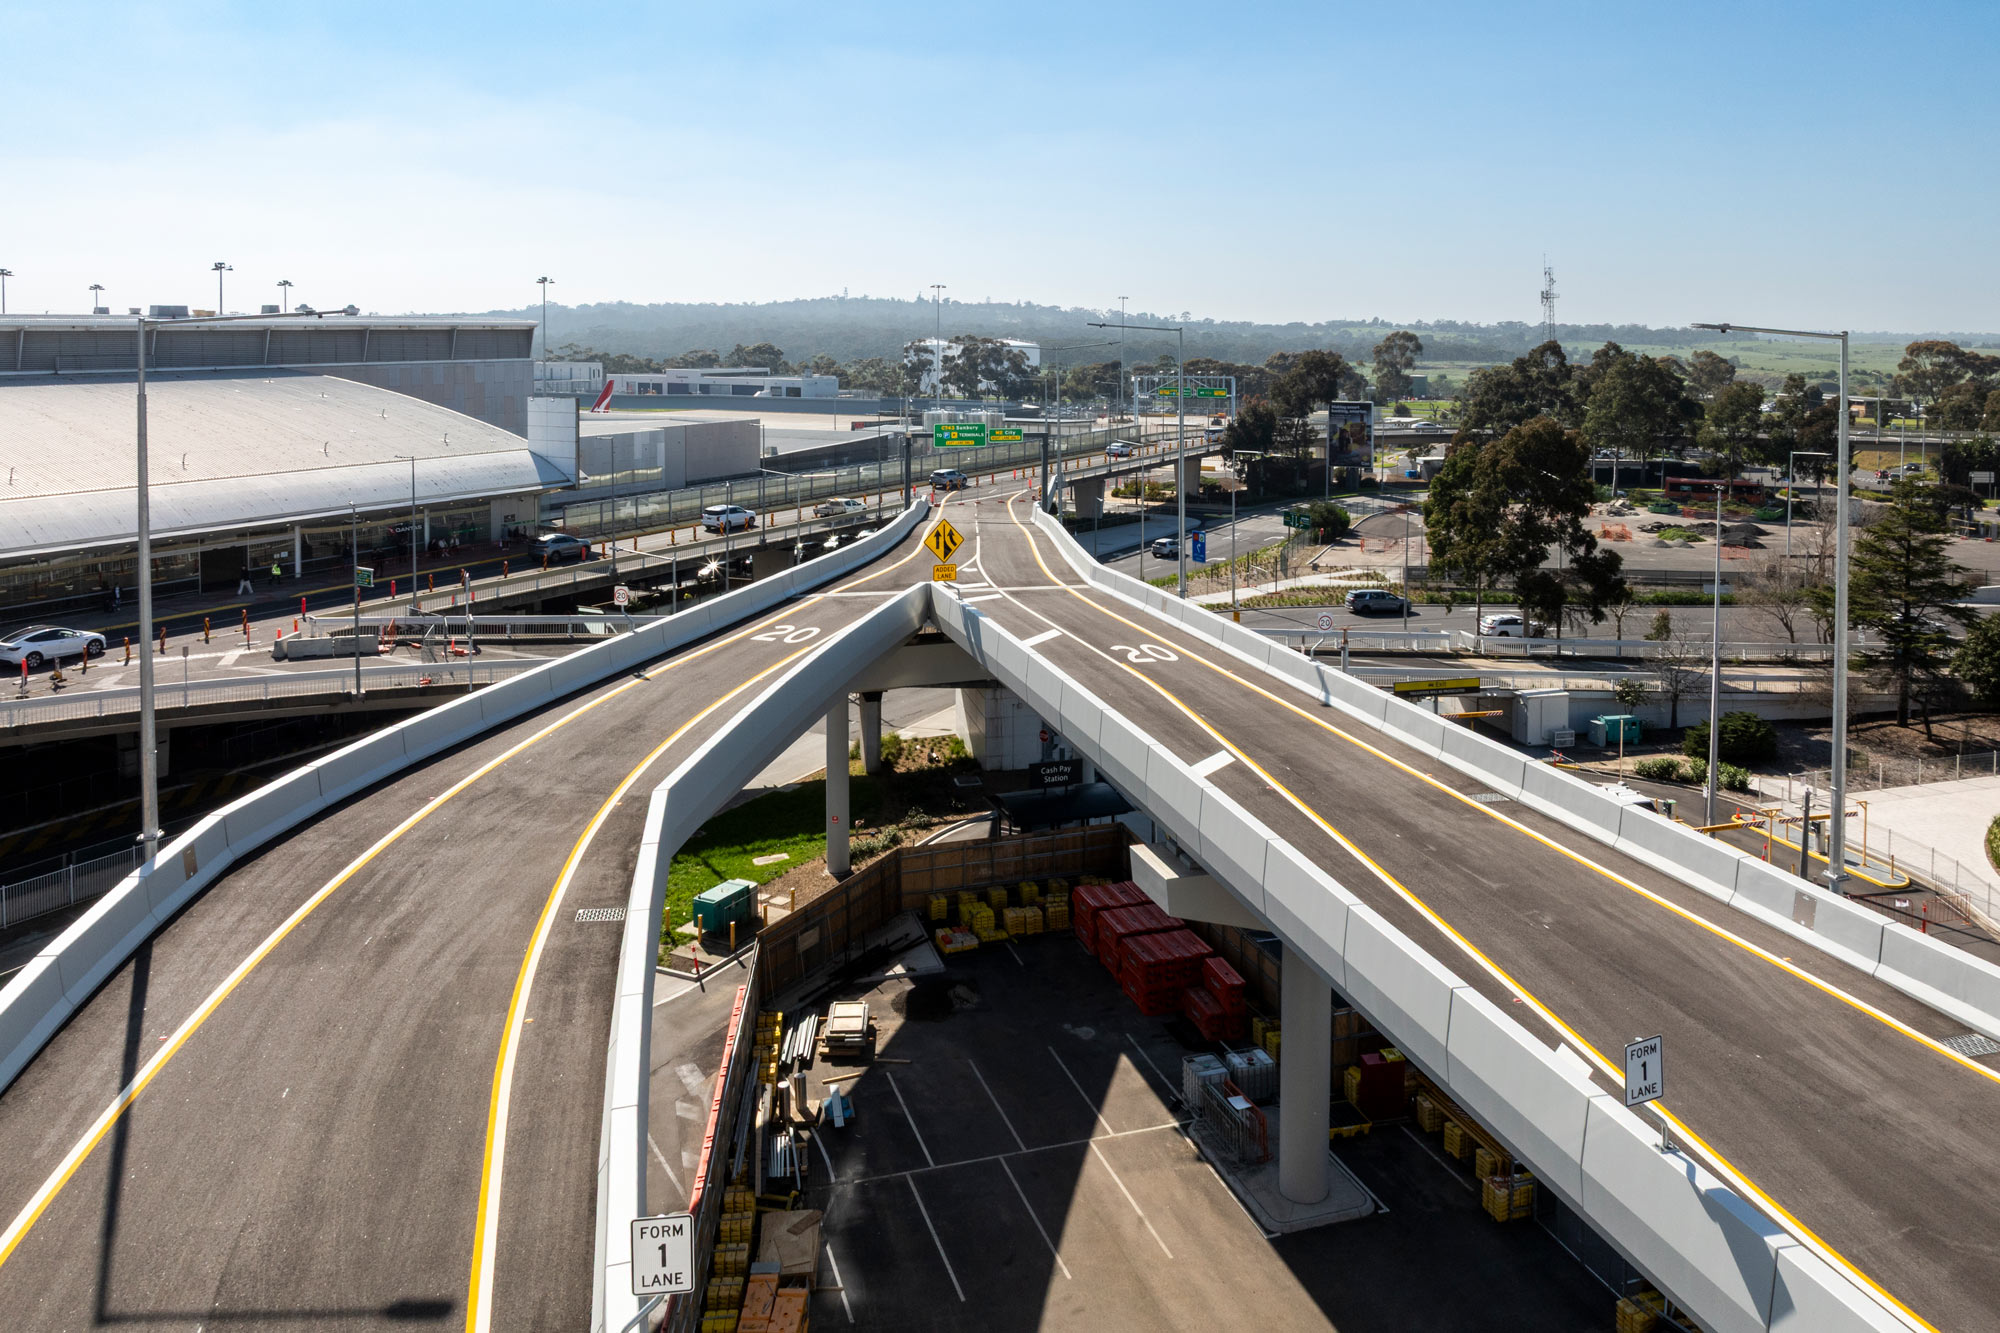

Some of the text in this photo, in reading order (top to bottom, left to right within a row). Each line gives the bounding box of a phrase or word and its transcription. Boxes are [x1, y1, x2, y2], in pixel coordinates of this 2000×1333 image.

[750, 625, 821, 643] 20
[1110, 644, 1179, 663] 20
[1041, 765, 1072, 774] Cash Pay
[1044, 775, 1069, 783] Station
[1630, 1043, 1657, 1060] FORM
[1641, 1061, 1647, 1081] 1
[1631, 1083, 1658, 1099] LANE
[640, 1224, 683, 1239] FORM
[658, 1243, 666, 1268] 1
[642, 1272, 683, 1287] LANE
